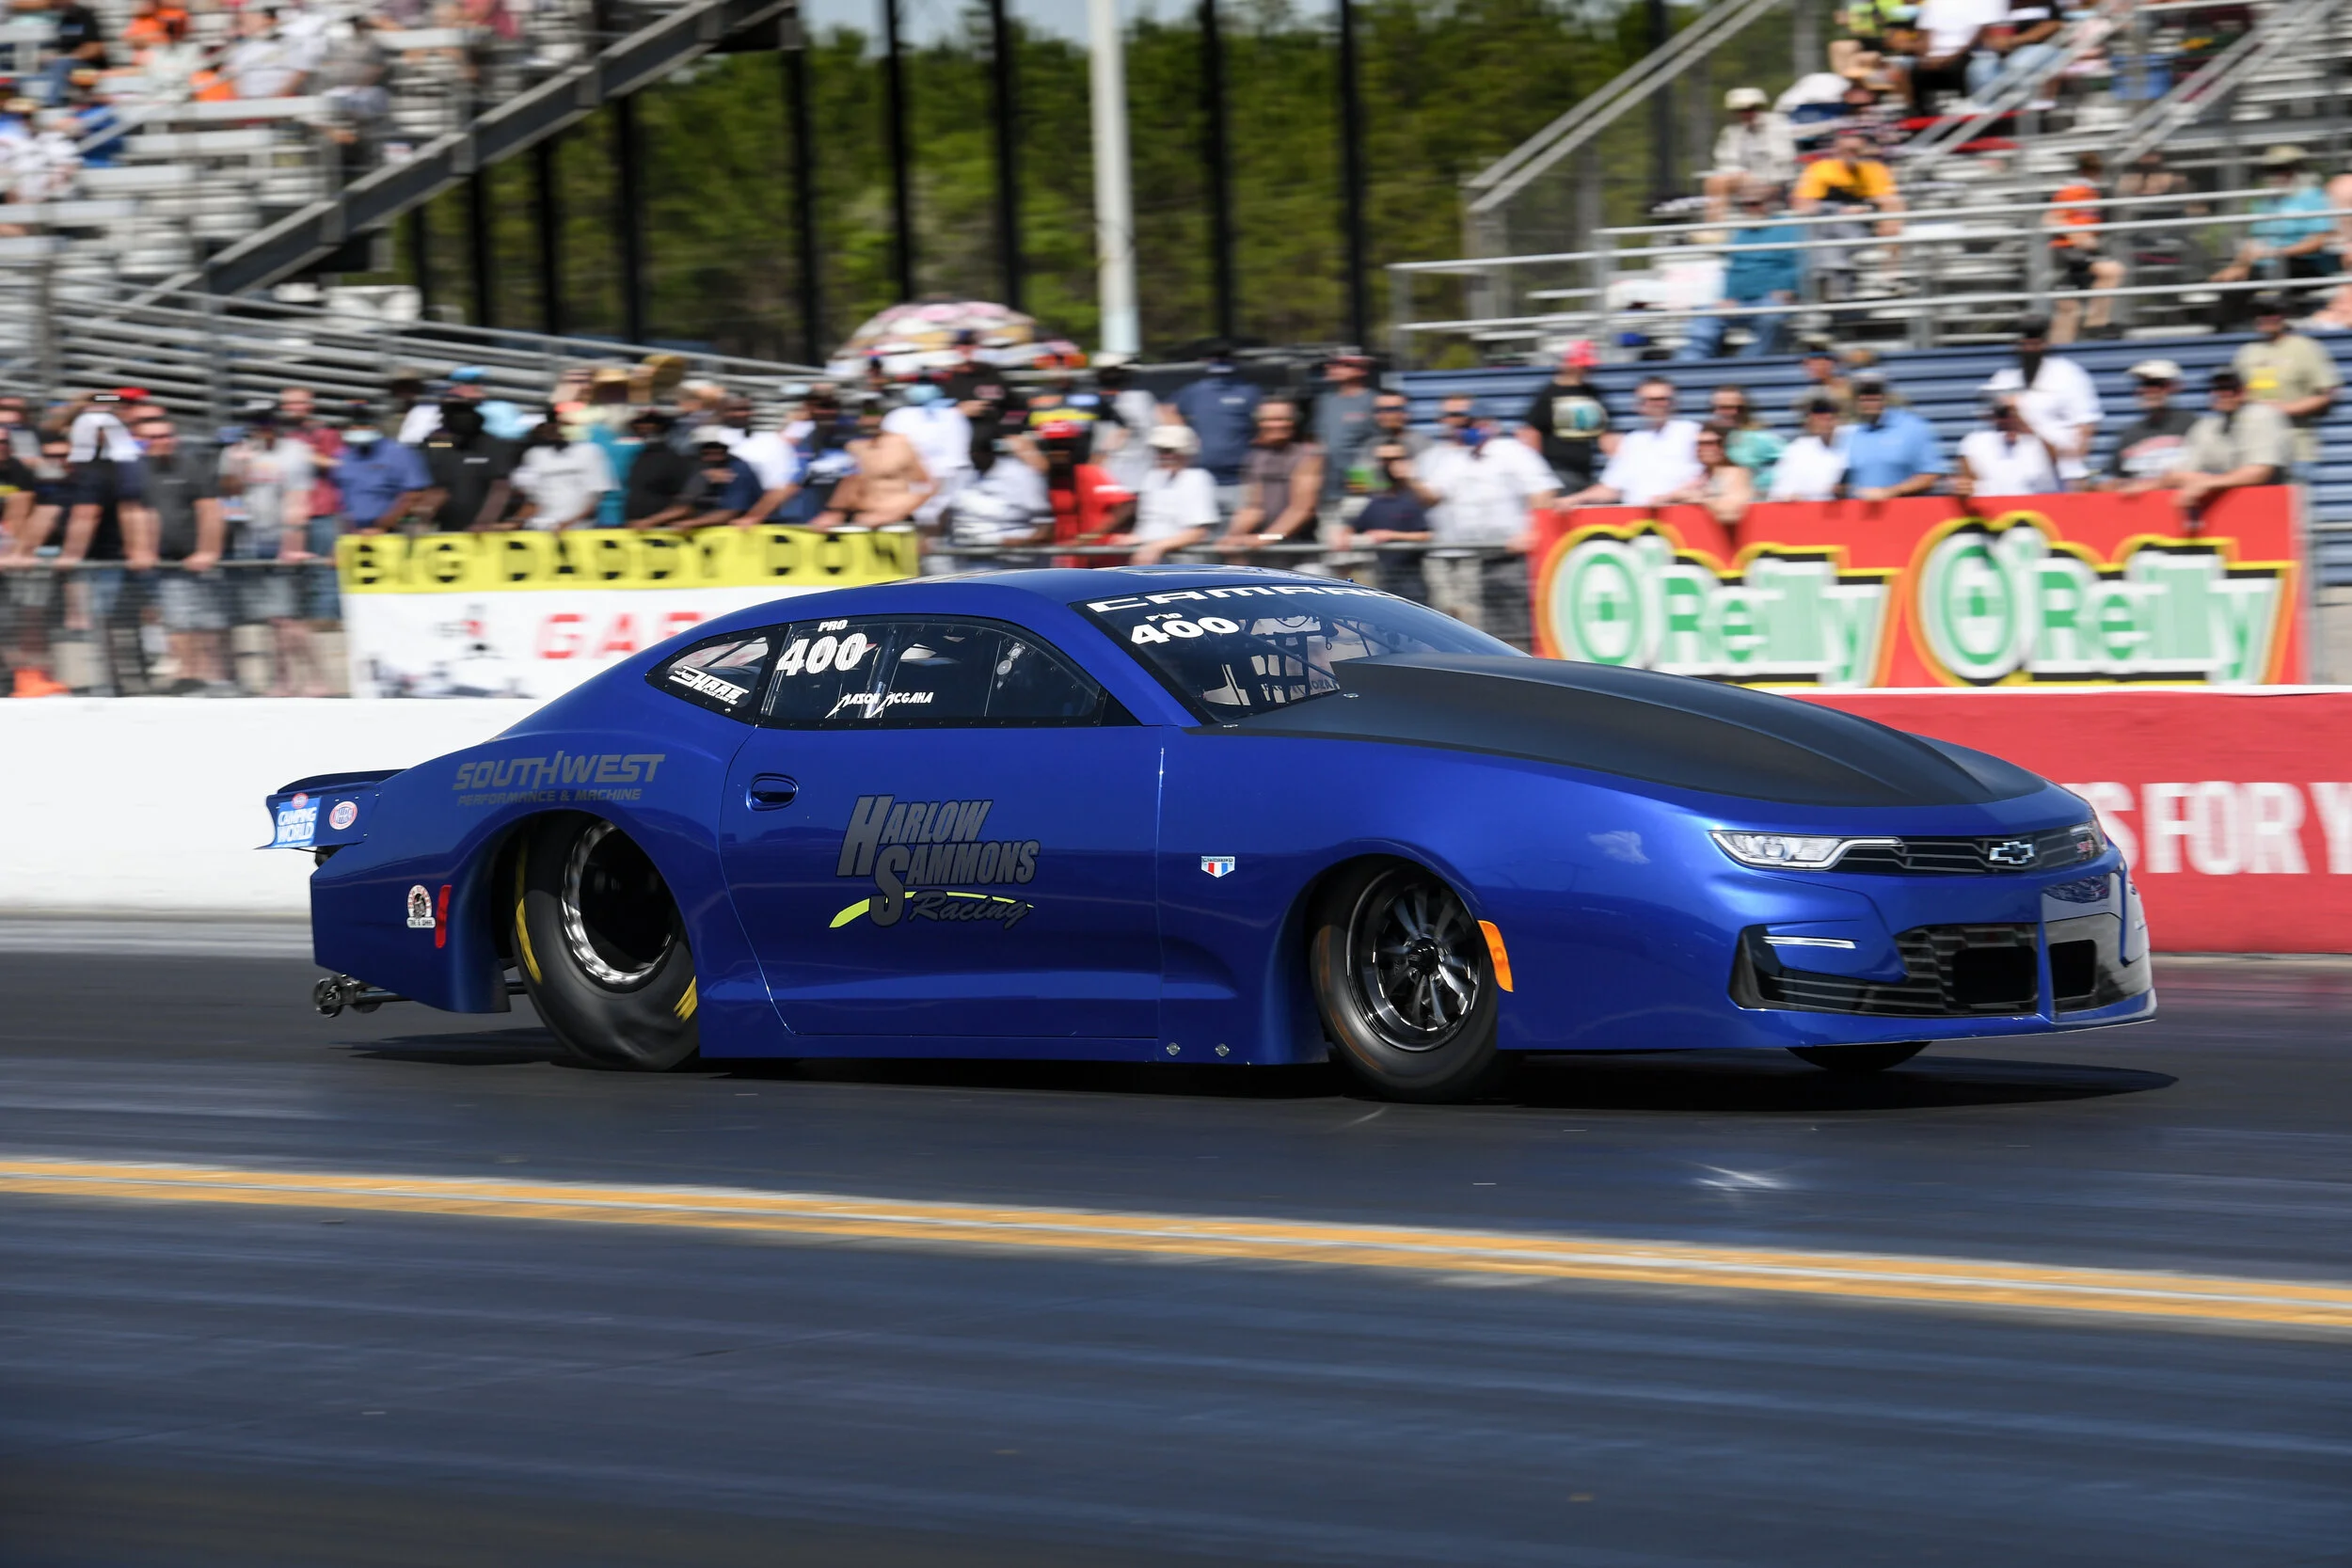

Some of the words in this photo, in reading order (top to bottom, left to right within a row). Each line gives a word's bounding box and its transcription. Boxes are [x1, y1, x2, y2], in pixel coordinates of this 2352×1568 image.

[348, 540, 469, 586] BIG
[499, 535, 726, 583] DADDY
[765, 531, 920, 578] DON
[818, 620, 849, 633] PRO
[1931, 531, 2273, 686] O'Reilly
[1131, 616, 1240, 645] 400
[776, 632, 868, 676] 400
[677, 665, 750, 701] HAAS
[825, 692, 882, 719] JASON
[452, 751, 665, 791] SOUTHWEST
[457, 787, 556, 807] PERFORMANCE
[560, 790, 570, 801] &
[575, 788, 643, 801] MACHINE
[277, 821, 314, 844] WORLD
[278, 807, 317, 827] CAMPING
[836, 794, 993, 877] HARLOW
[2140, 781, 2311, 876] FOR
[868, 840, 1041, 927] SAMMONS
[907, 890, 1030, 929] Racing
